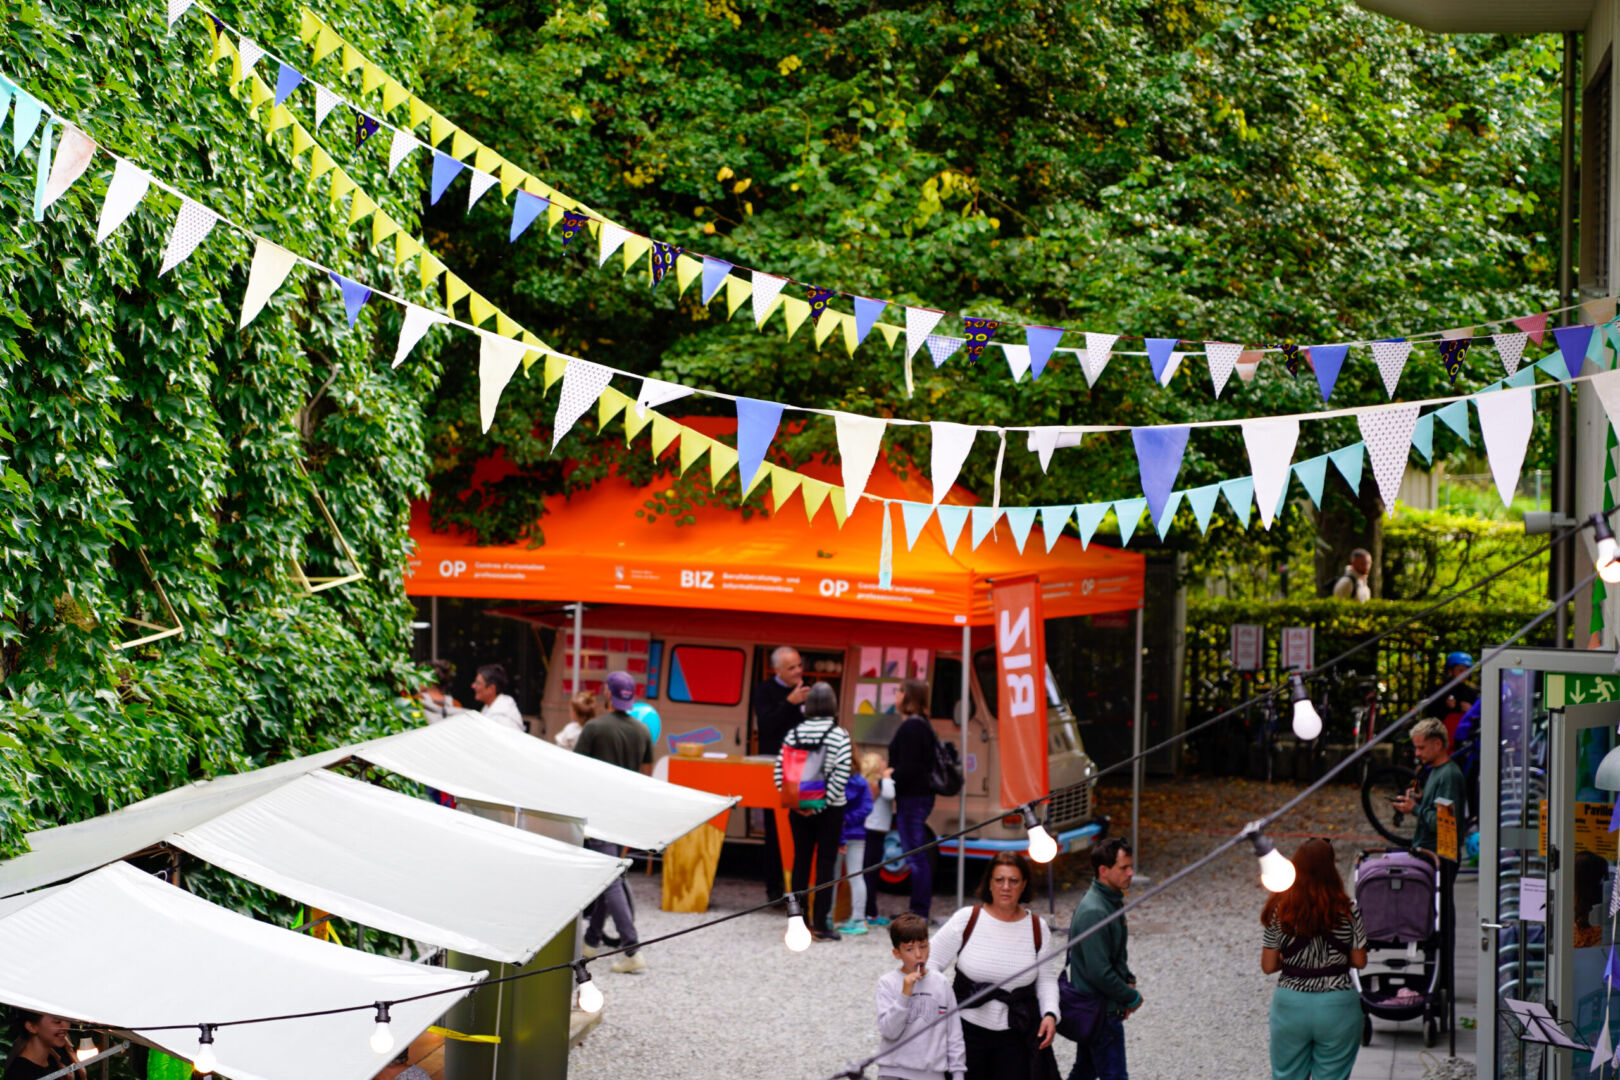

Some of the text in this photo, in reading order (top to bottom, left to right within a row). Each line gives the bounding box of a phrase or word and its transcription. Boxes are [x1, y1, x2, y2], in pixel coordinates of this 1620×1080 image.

[439, 560, 466, 577] OP
[680, 569, 714, 589] BIZ
[819, 578, 849, 597] OP
